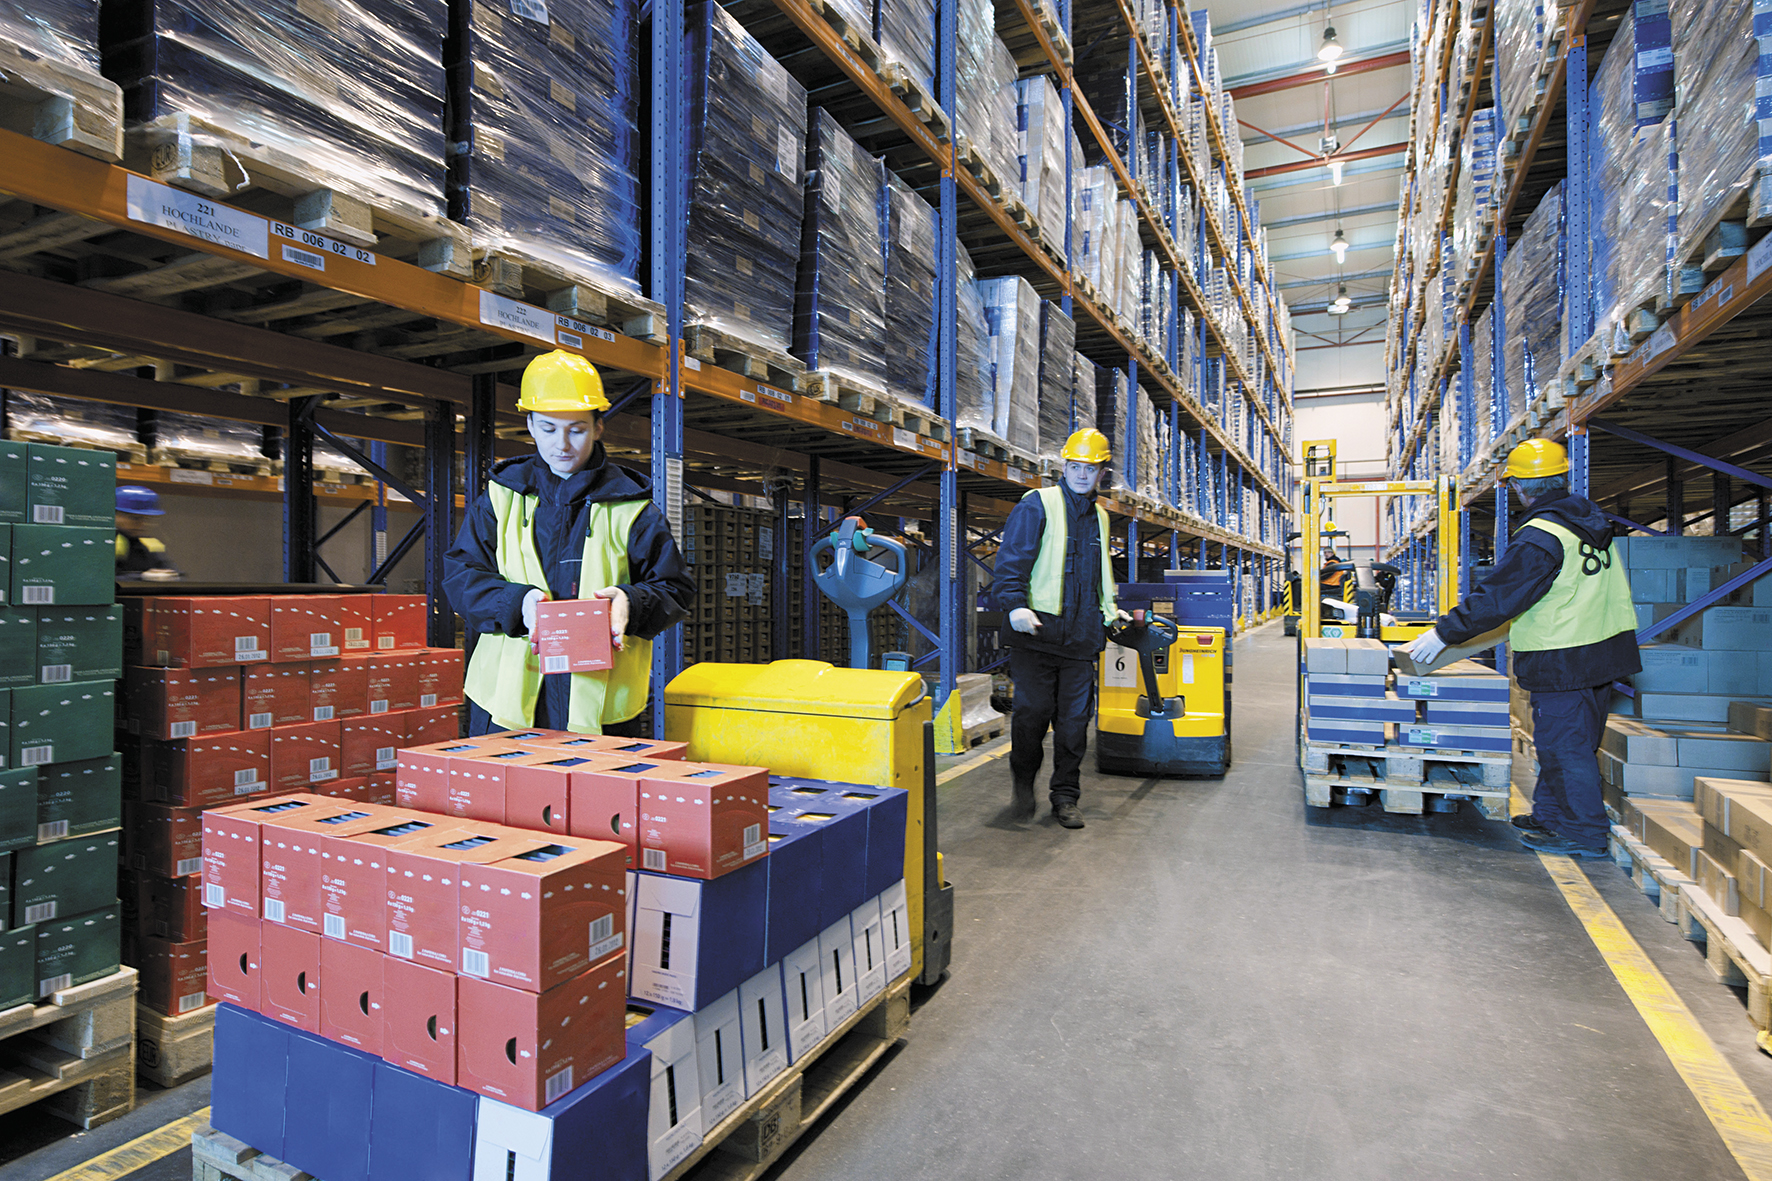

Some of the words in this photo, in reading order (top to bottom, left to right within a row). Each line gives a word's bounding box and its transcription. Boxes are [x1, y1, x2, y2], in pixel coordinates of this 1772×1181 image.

[197, 203, 215, 216] 221
[162, 204, 240, 238] HOCHLANDE
[274, 224, 294, 238] RB
[302, 232, 324, 248] 006
[332, 241, 346, 255] 02
[356, 249, 370, 262] 02
[498, 310, 540, 330] HOCHLANDE
[558, 316, 570, 327] RB
[574, 322, 586, 333] 006
[590, 327, 598, 336] 02
[604, 332, 612, 340] 03
[1115, 656, 1125, 671] 6
